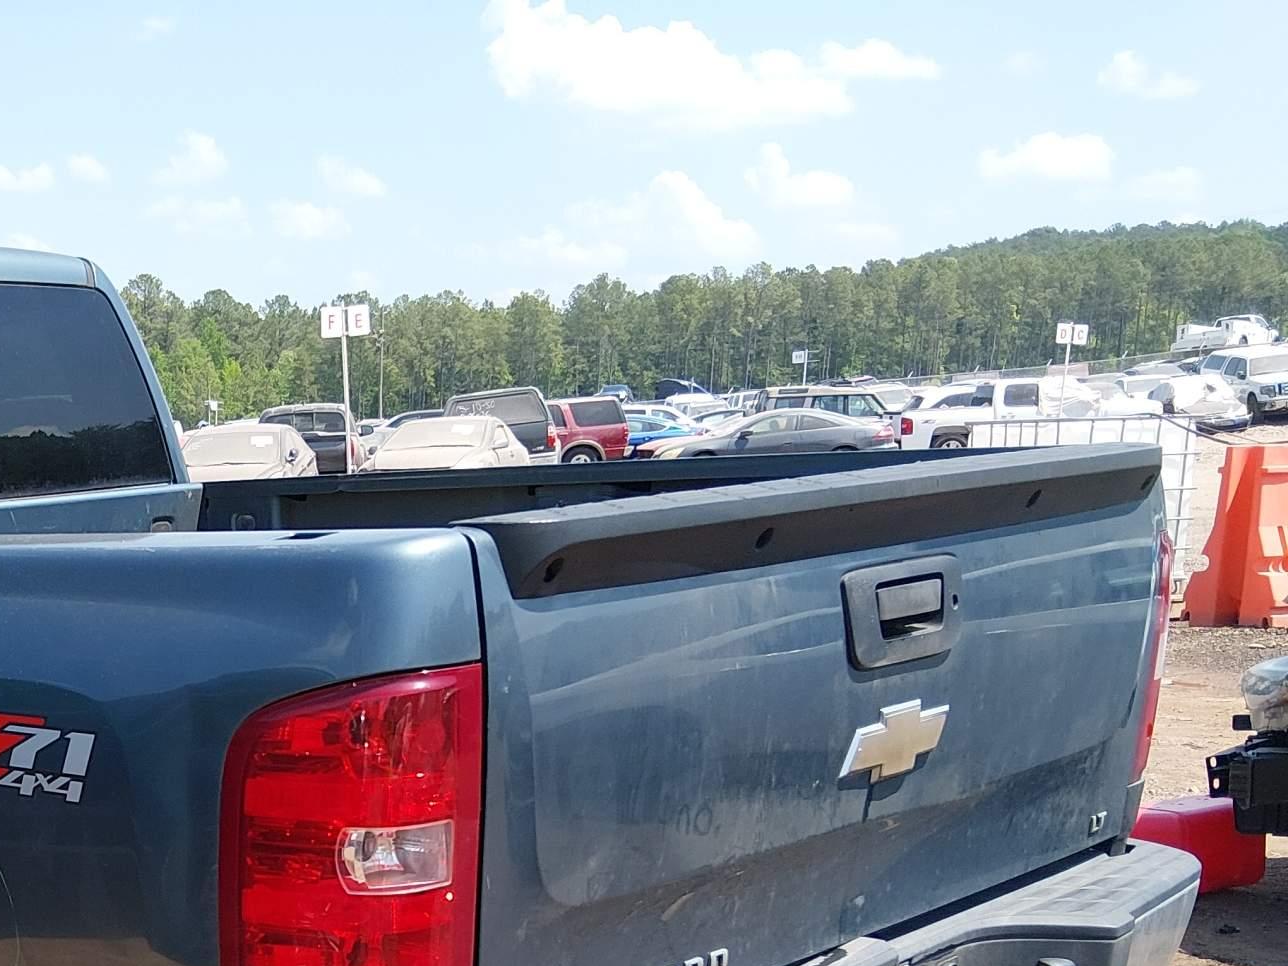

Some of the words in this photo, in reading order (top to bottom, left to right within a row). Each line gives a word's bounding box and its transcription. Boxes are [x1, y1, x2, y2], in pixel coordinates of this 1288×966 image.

[328, 314, 335, 329] F
[355, 313, 363, 328] E
[1089, 810, 1108, 833] LT
